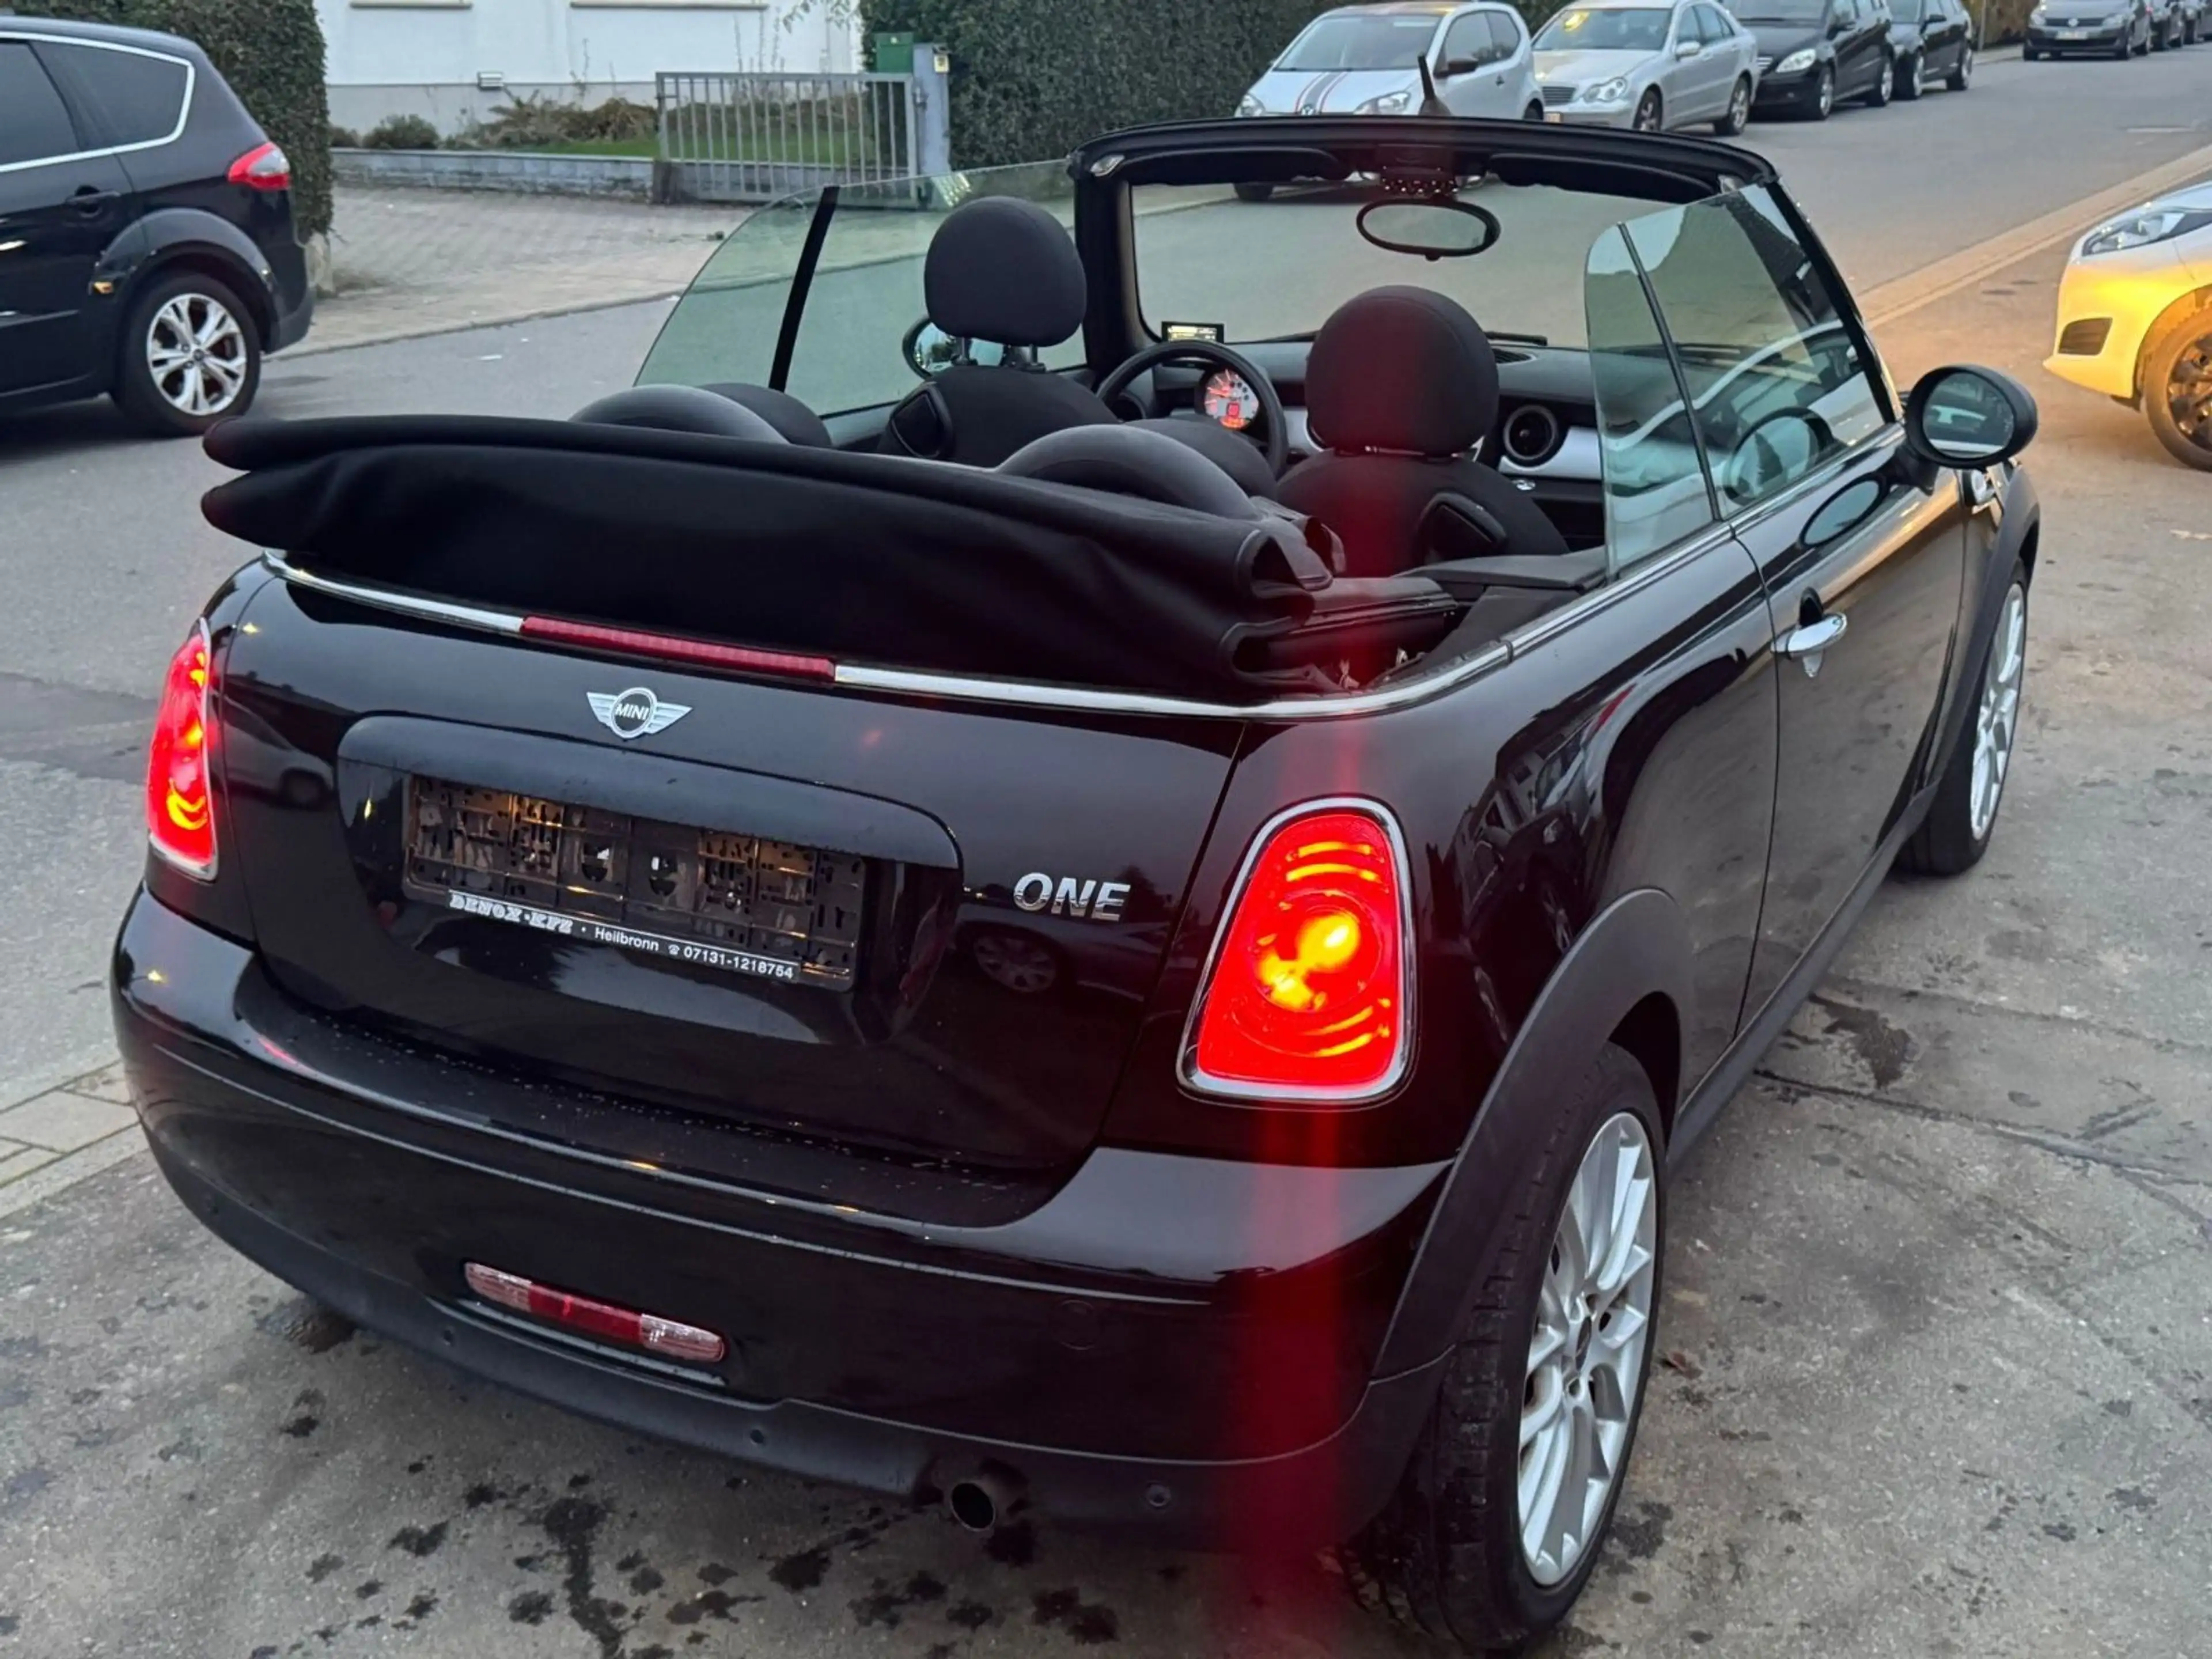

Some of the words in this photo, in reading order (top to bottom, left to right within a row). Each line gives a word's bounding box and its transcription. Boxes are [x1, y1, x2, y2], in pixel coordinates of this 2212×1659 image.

[615, 703, 650, 720] MINI
[1013, 872, 1131, 922] ONE
[594, 926, 659, 951] Heilbronn
